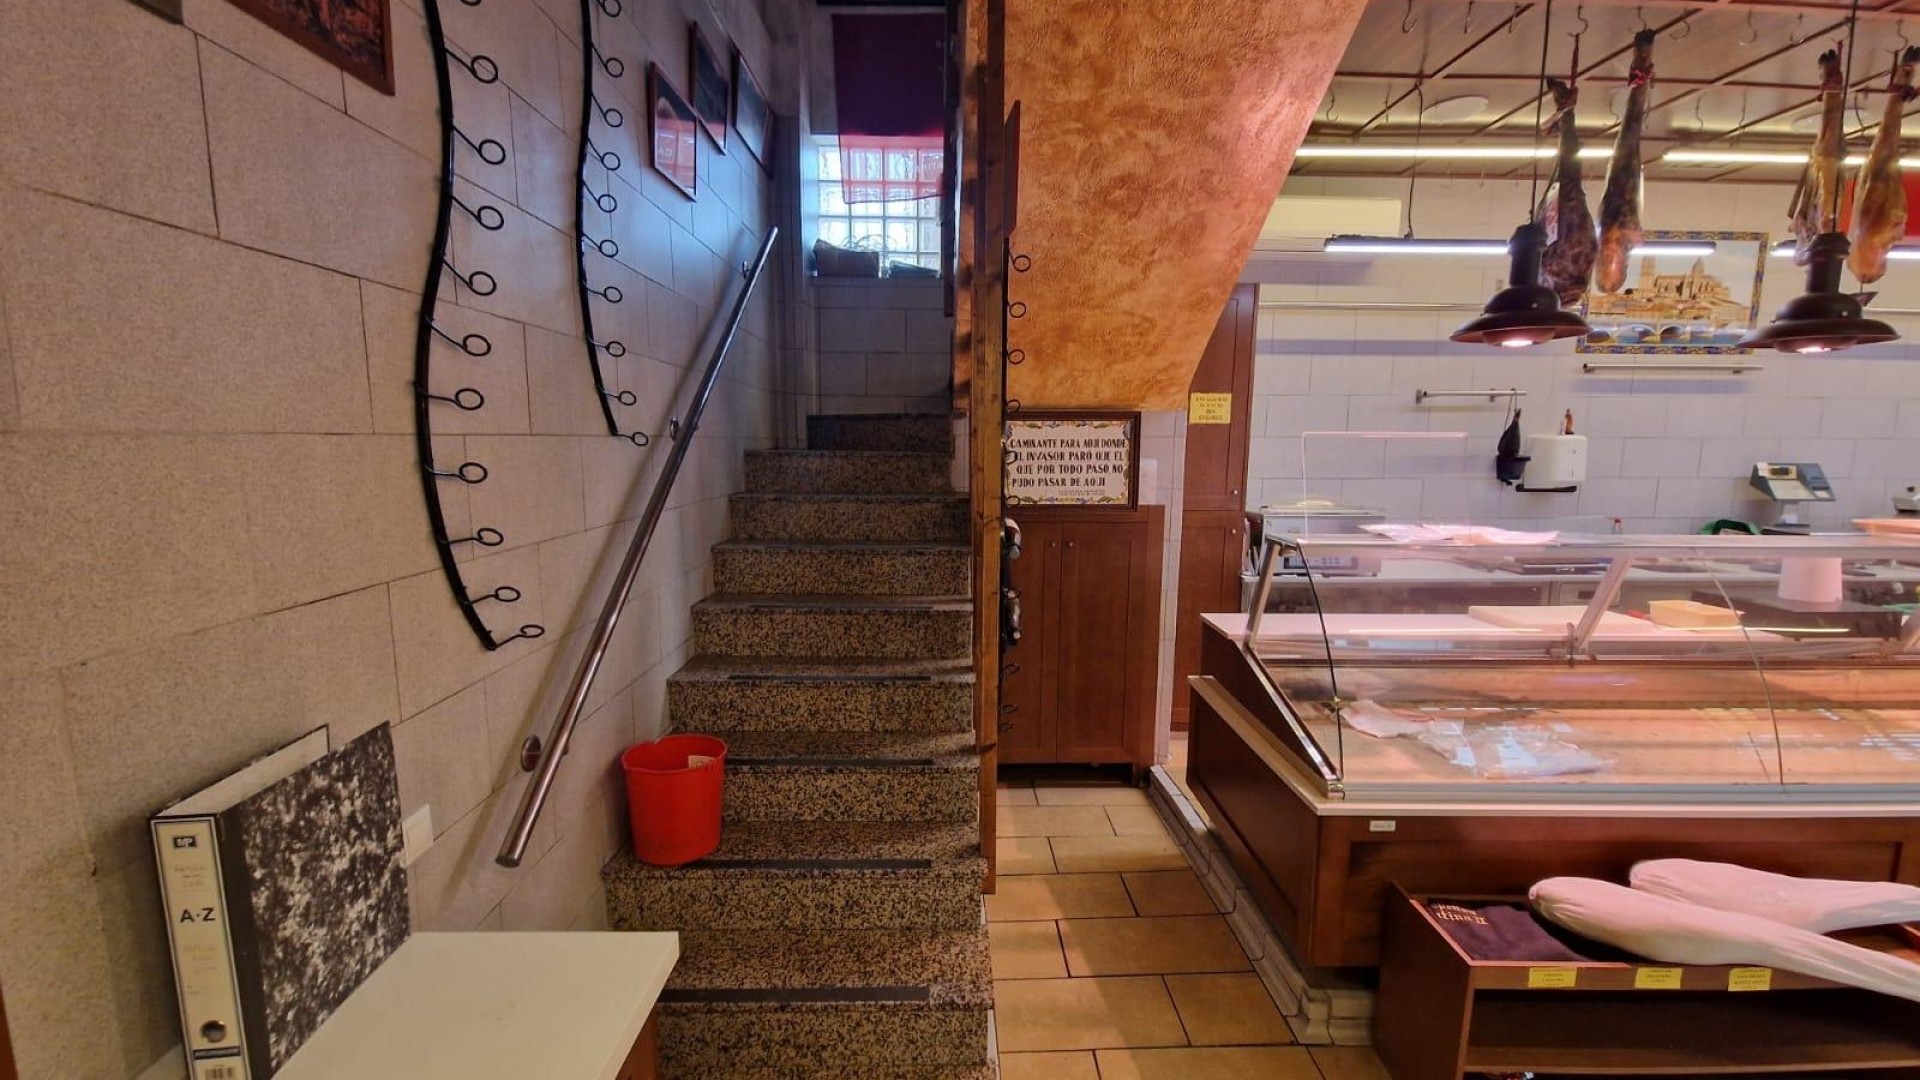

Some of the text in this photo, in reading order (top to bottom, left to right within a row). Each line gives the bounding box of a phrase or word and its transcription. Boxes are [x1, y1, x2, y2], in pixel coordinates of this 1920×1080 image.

[1010, 439, 1057, 449] CAMINANTE
[1061, 439, 1080, 448] PARA
[1027, 451, 1065, 461] INVASOR
[1037, 465, 1055, 474] POR
[1060, 464, 1082, 474] TODO
[1038, 478, 1066, 487] PASAR
[1070, 478, 1081, 486] DE
